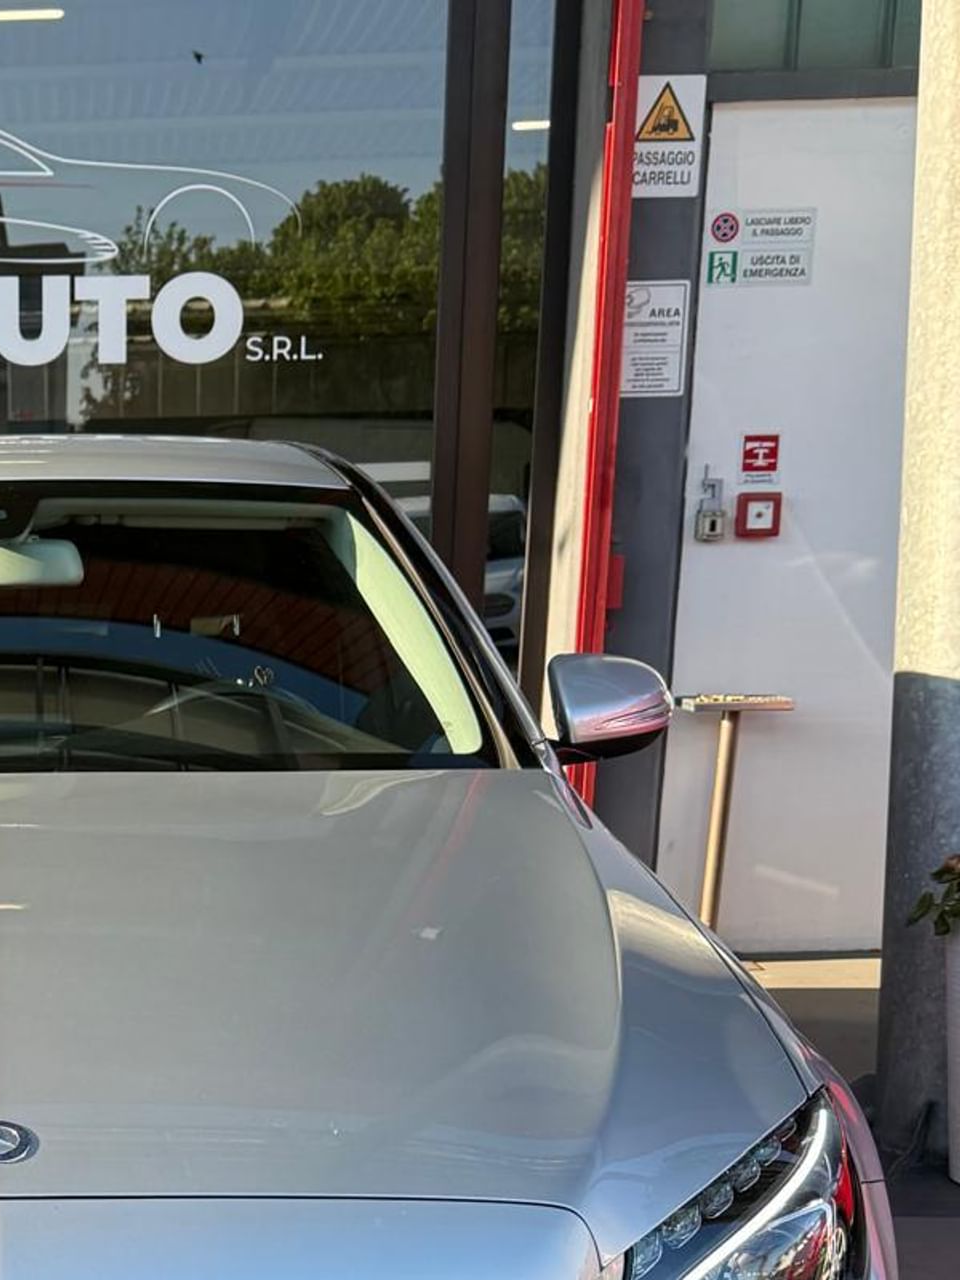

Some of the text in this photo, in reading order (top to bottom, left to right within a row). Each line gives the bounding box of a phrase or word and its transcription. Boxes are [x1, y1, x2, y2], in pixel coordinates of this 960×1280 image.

[632, 170, 691, 185] CARRELLI
[745, 216, 812, 226] LASCIARE LIBERO
[760, 227, 803, 236] PASSAGGIO
[750, 254, 801, 266] USCITA DI
[743, 267, 806, 278] EMERGENZA
[649, 307, 681, 318] AREA
[245, 334, 323, 362] S.R.L.
